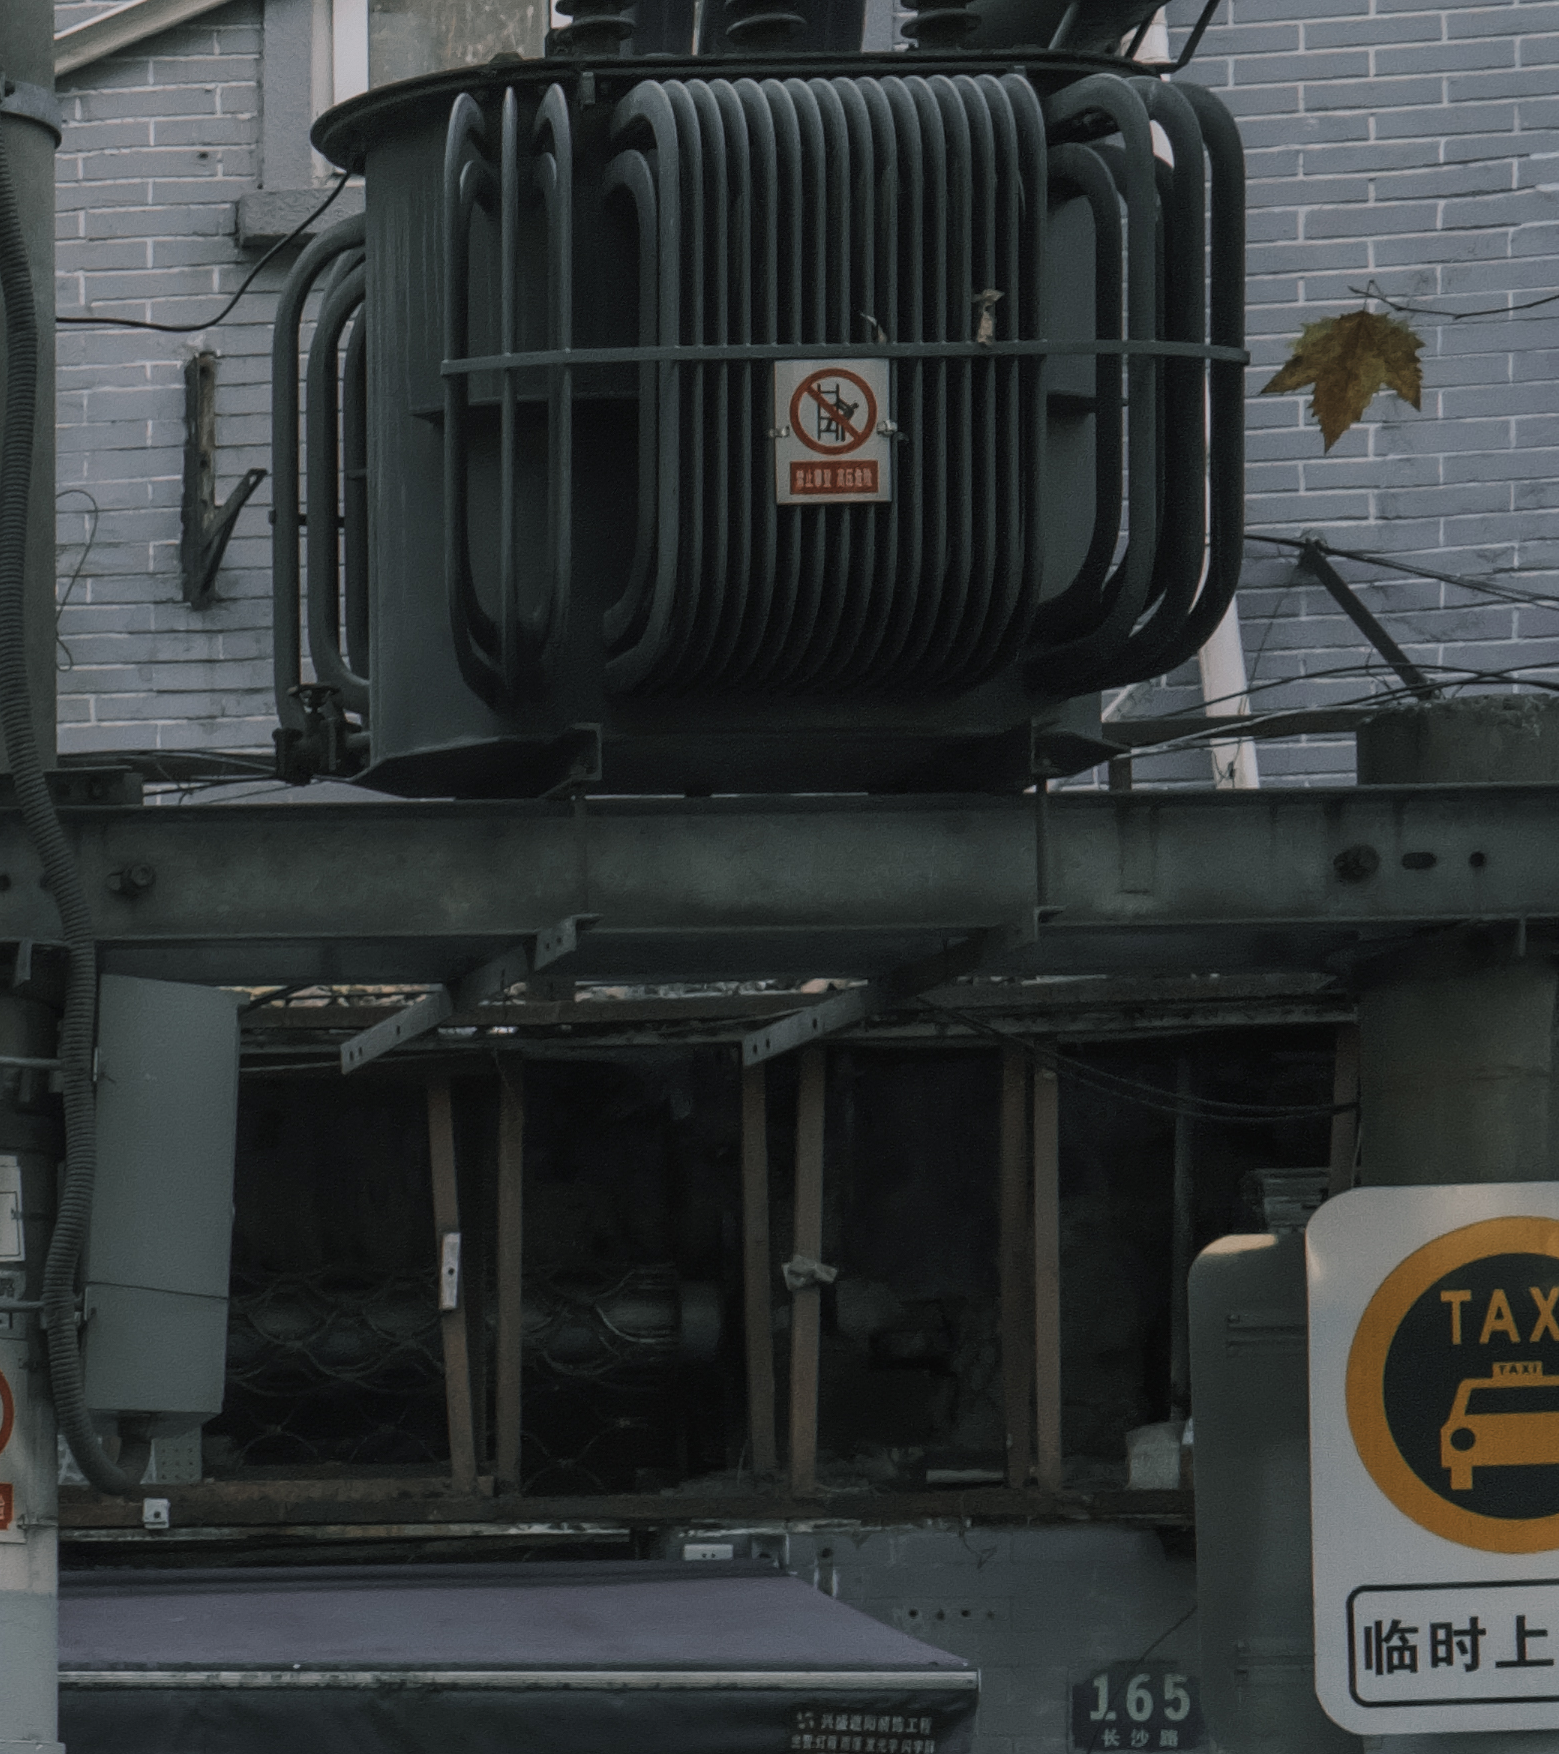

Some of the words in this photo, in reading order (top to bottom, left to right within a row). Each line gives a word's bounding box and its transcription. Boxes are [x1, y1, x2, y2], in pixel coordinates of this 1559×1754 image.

[1498, 1362, 1540, 1375] TAXI
[1090, 1672, 1191, 1722] 165
[1102, 1728, 1179, 1748] 长沙路
